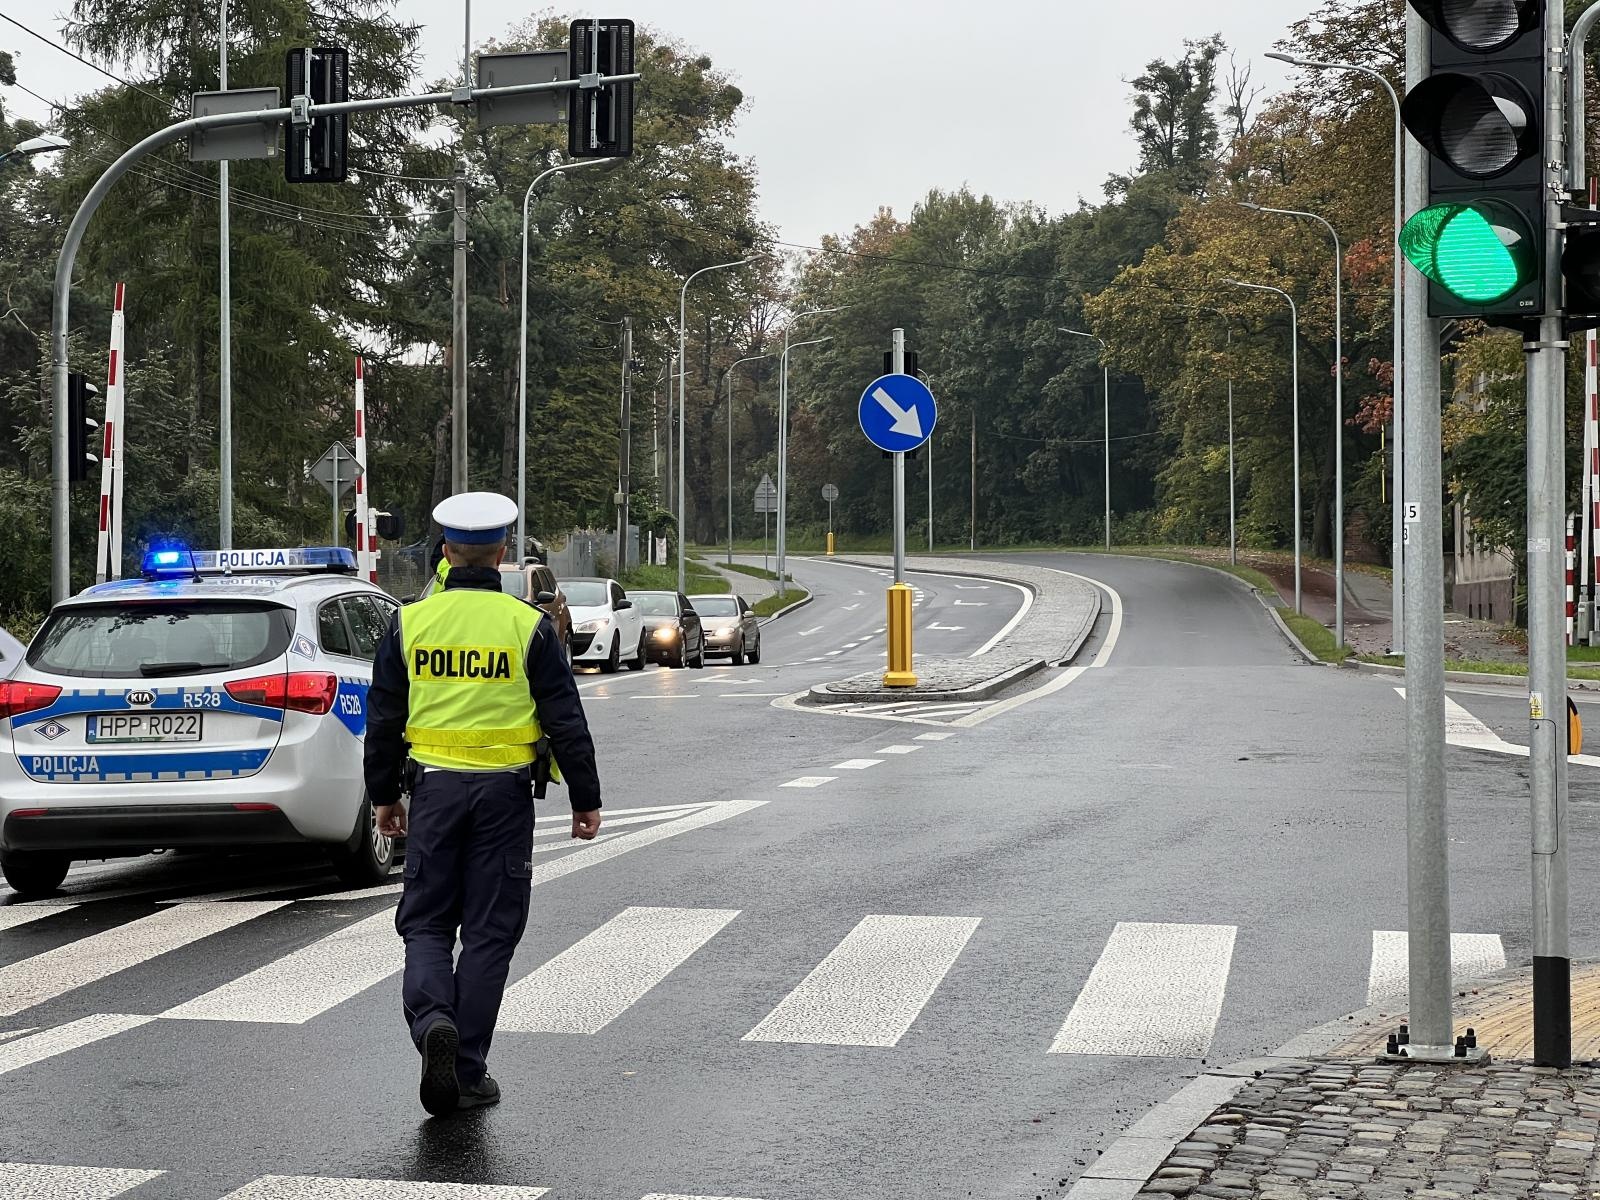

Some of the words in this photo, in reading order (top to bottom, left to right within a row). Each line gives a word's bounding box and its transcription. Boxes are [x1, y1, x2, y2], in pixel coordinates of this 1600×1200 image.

[220, 552, 285, 567] POLICJA
[415, 648, 510, 679] POLICJA
[131, 693, 150, 702] KIA
[183, 692, 221, 708] R528
[339, 694, 362, 715] R528
[100, 716, 142, 736] HPP
[149, 715, 197, 736] R022
[32, 756, 100, 773] POLICJA
